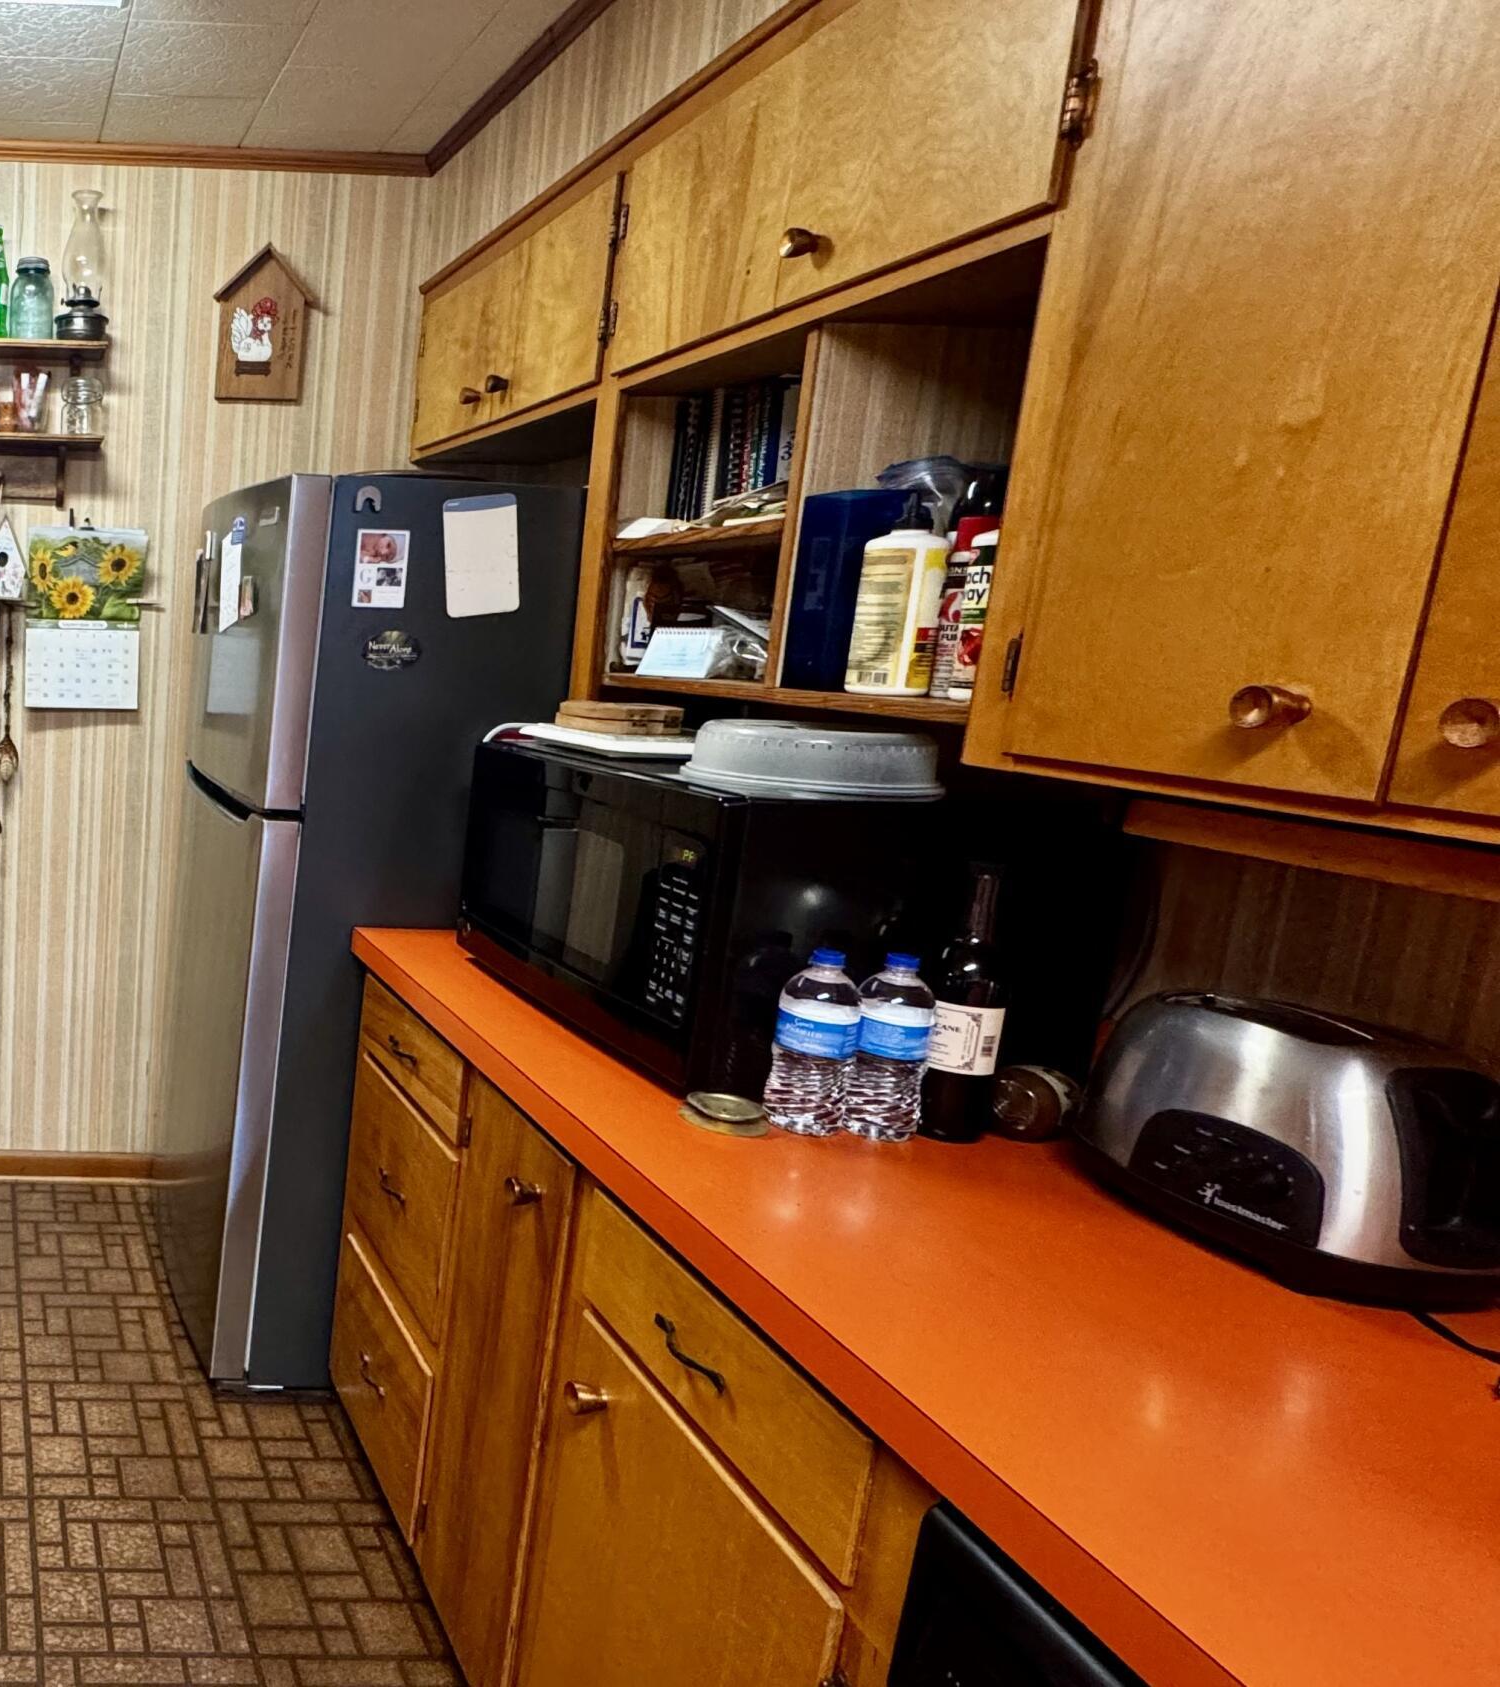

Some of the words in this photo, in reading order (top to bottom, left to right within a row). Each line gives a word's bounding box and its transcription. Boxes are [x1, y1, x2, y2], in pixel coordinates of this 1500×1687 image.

[966, 588, 987, 605] ay
[368, 640, 391, 652] Never
[388, 644, 412, 654] Alone
